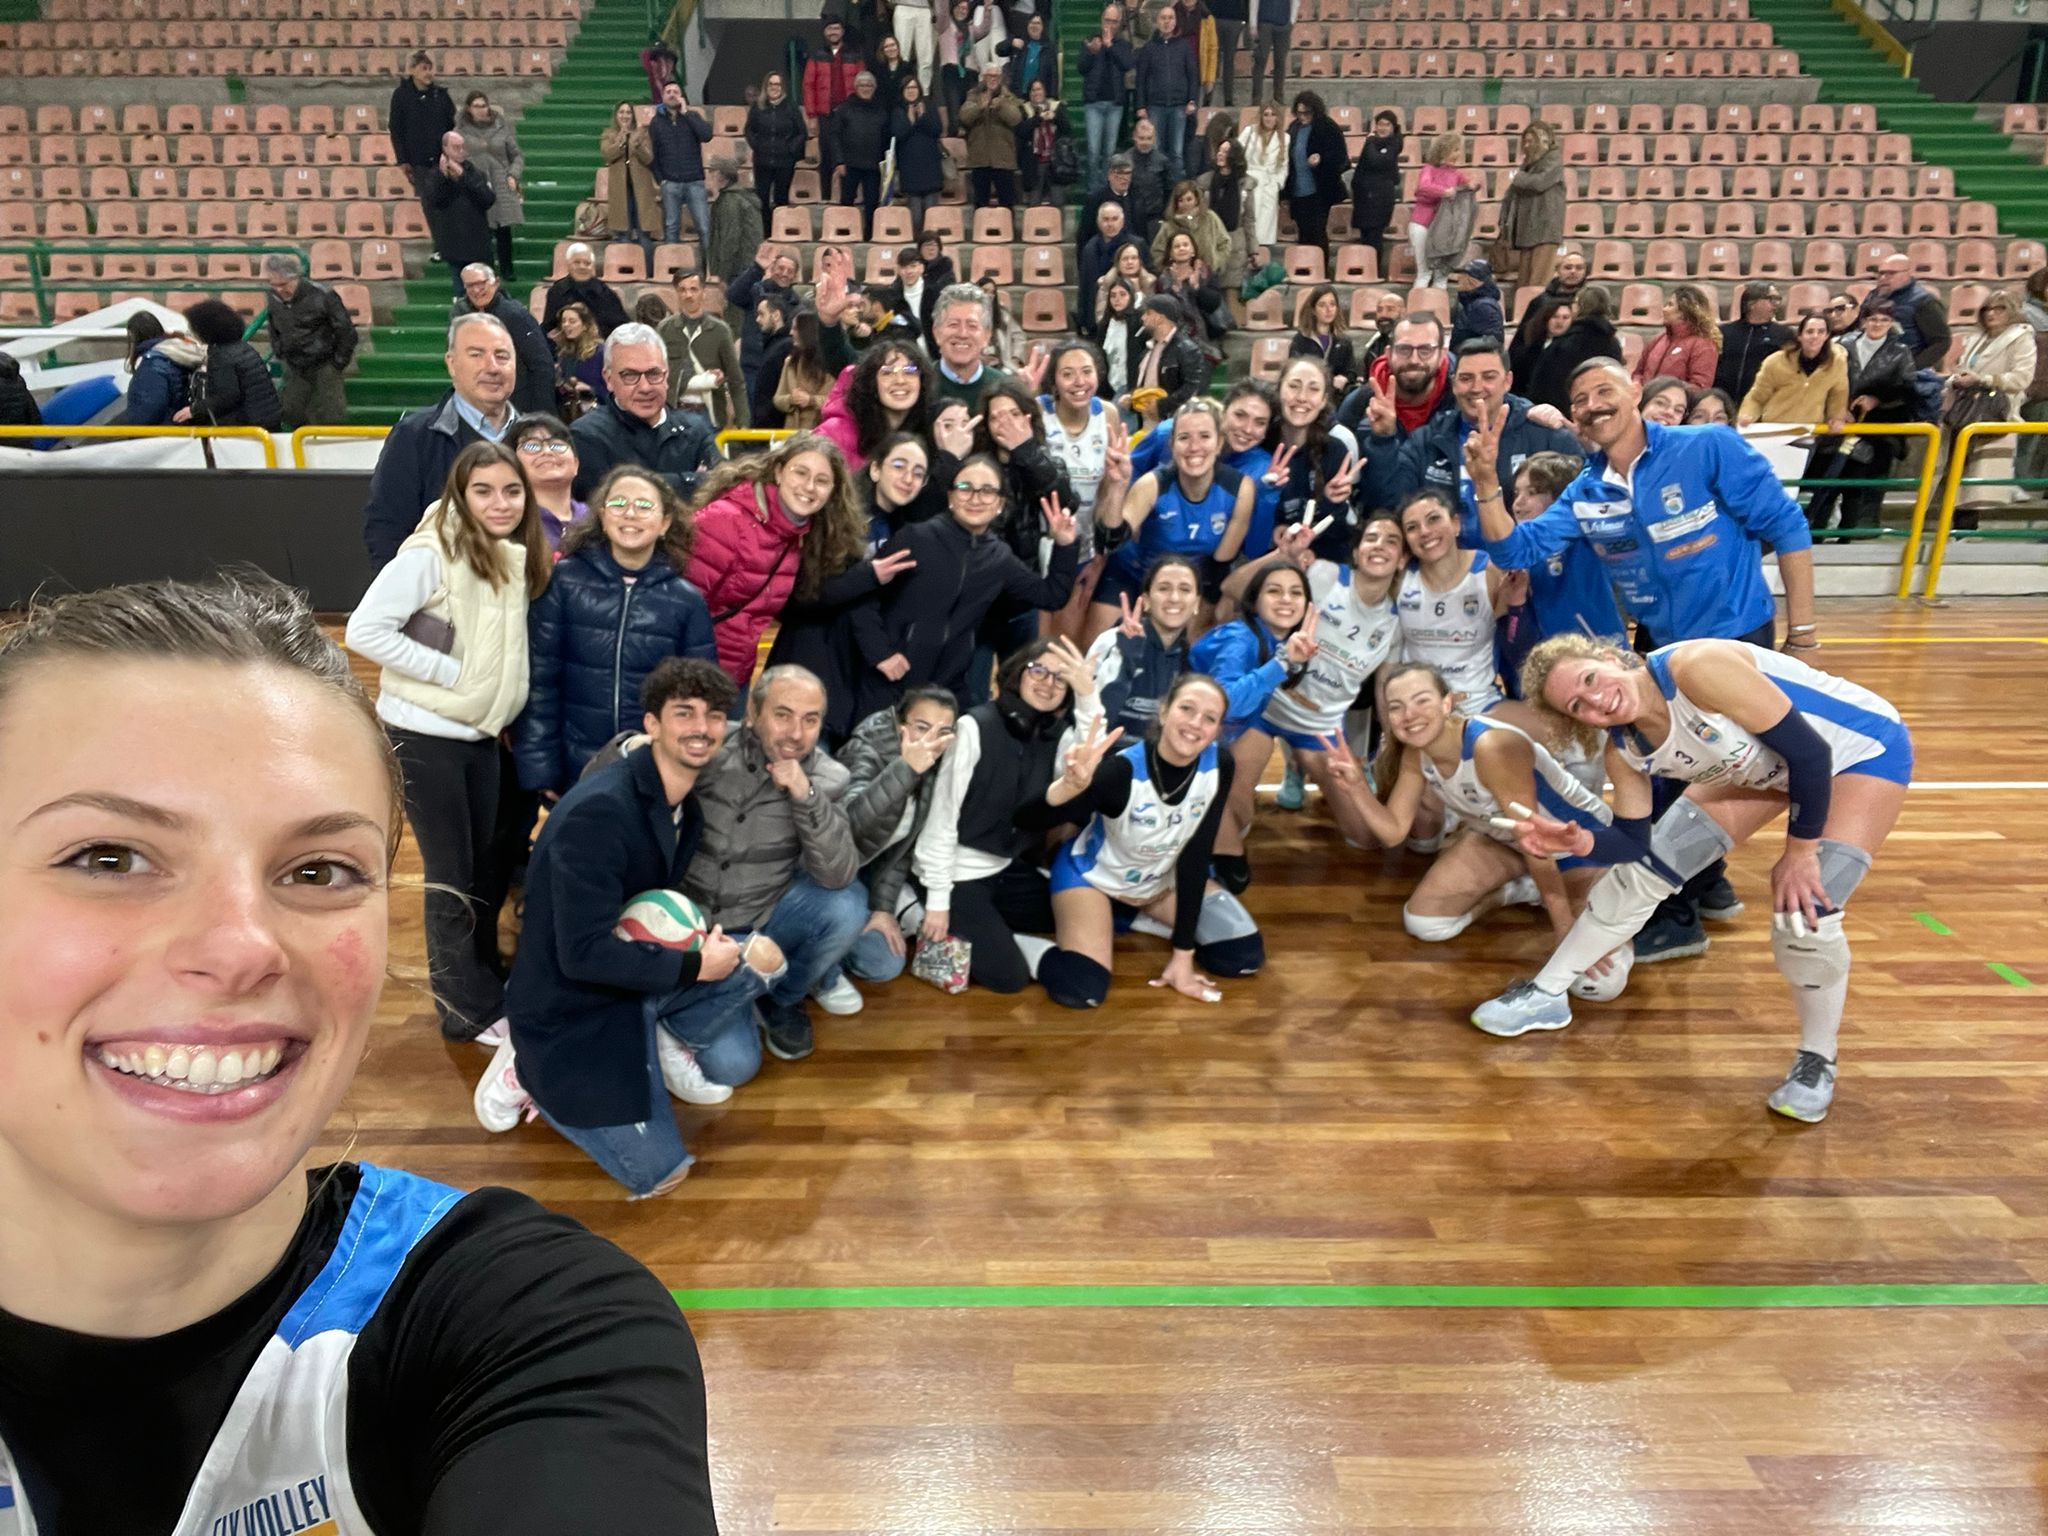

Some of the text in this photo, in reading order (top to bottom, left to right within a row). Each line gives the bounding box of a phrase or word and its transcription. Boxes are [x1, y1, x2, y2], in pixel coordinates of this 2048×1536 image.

[1188, 523, 1200, 539] 7
[1434, 601, 1446, 616] 6
[1347, 625, 1360, 640] 2
[1674, 750, 1694, 766] 3
[243, 1475, 331, 1536] VOLLEY
